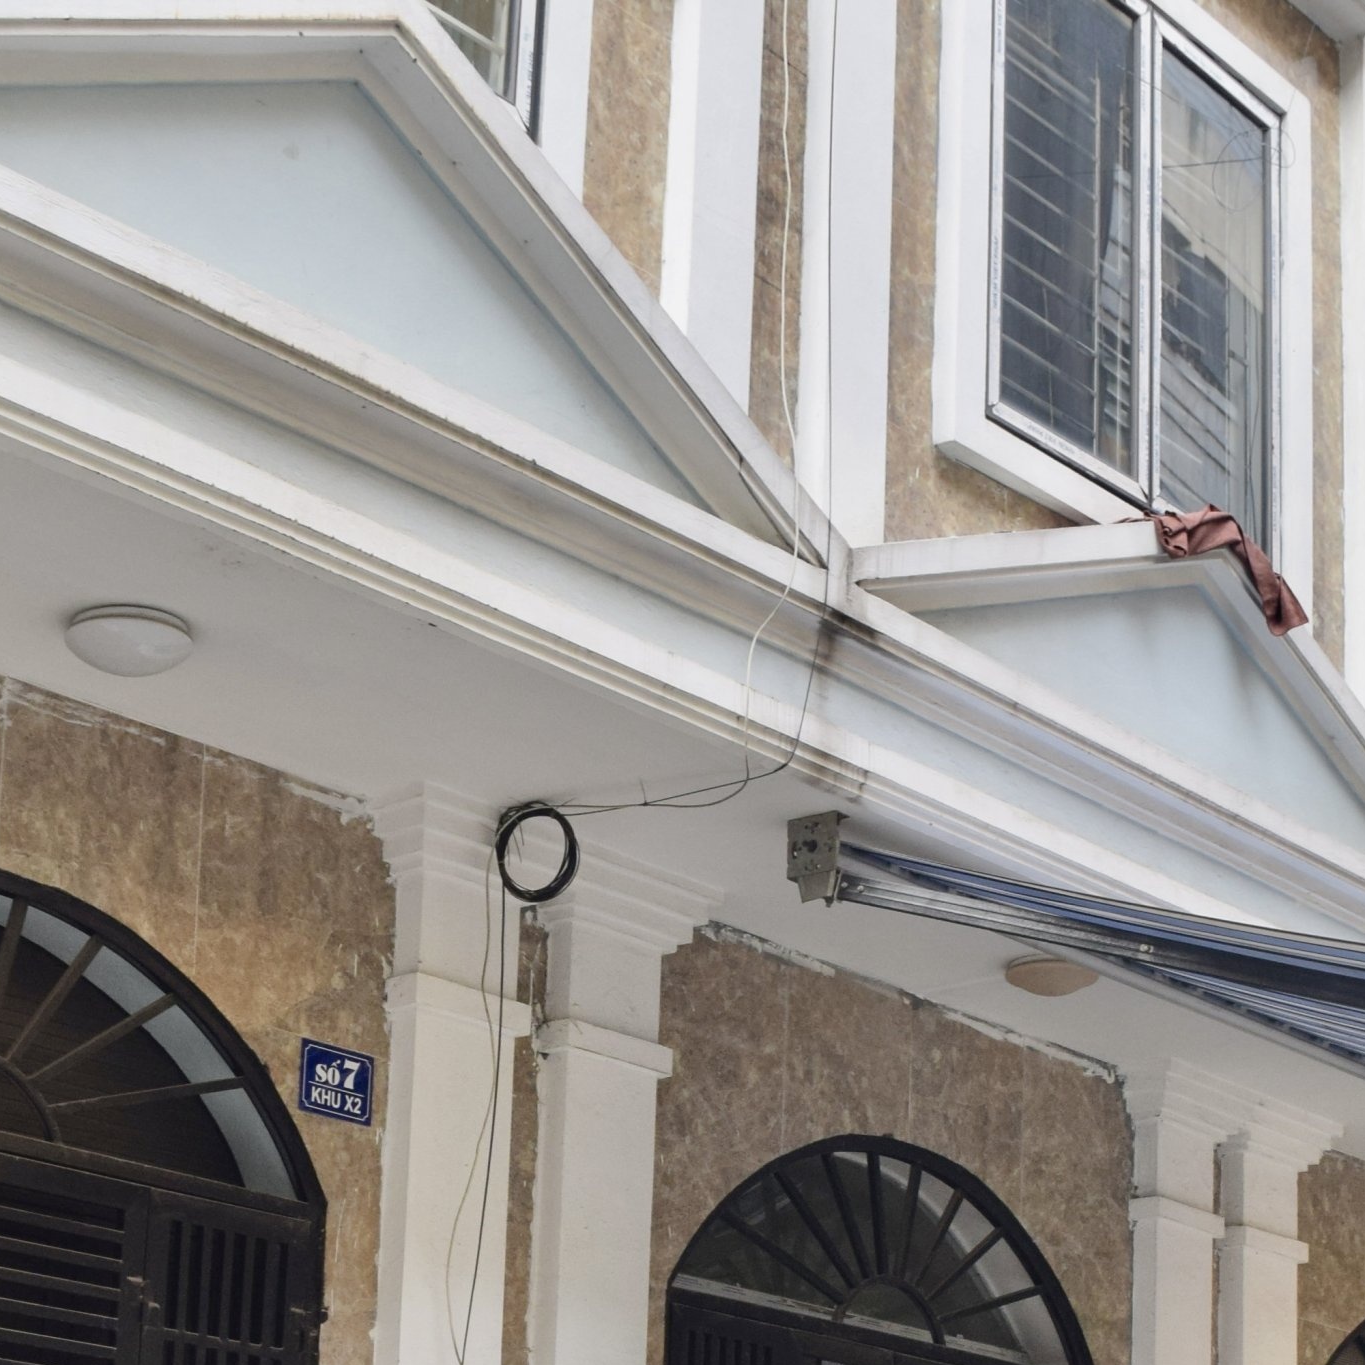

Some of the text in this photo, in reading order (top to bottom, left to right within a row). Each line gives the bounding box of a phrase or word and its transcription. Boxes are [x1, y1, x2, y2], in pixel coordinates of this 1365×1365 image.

[343, 1059, 361, 1090] 7
[311, 1086, 362, 1115] KHU X2
